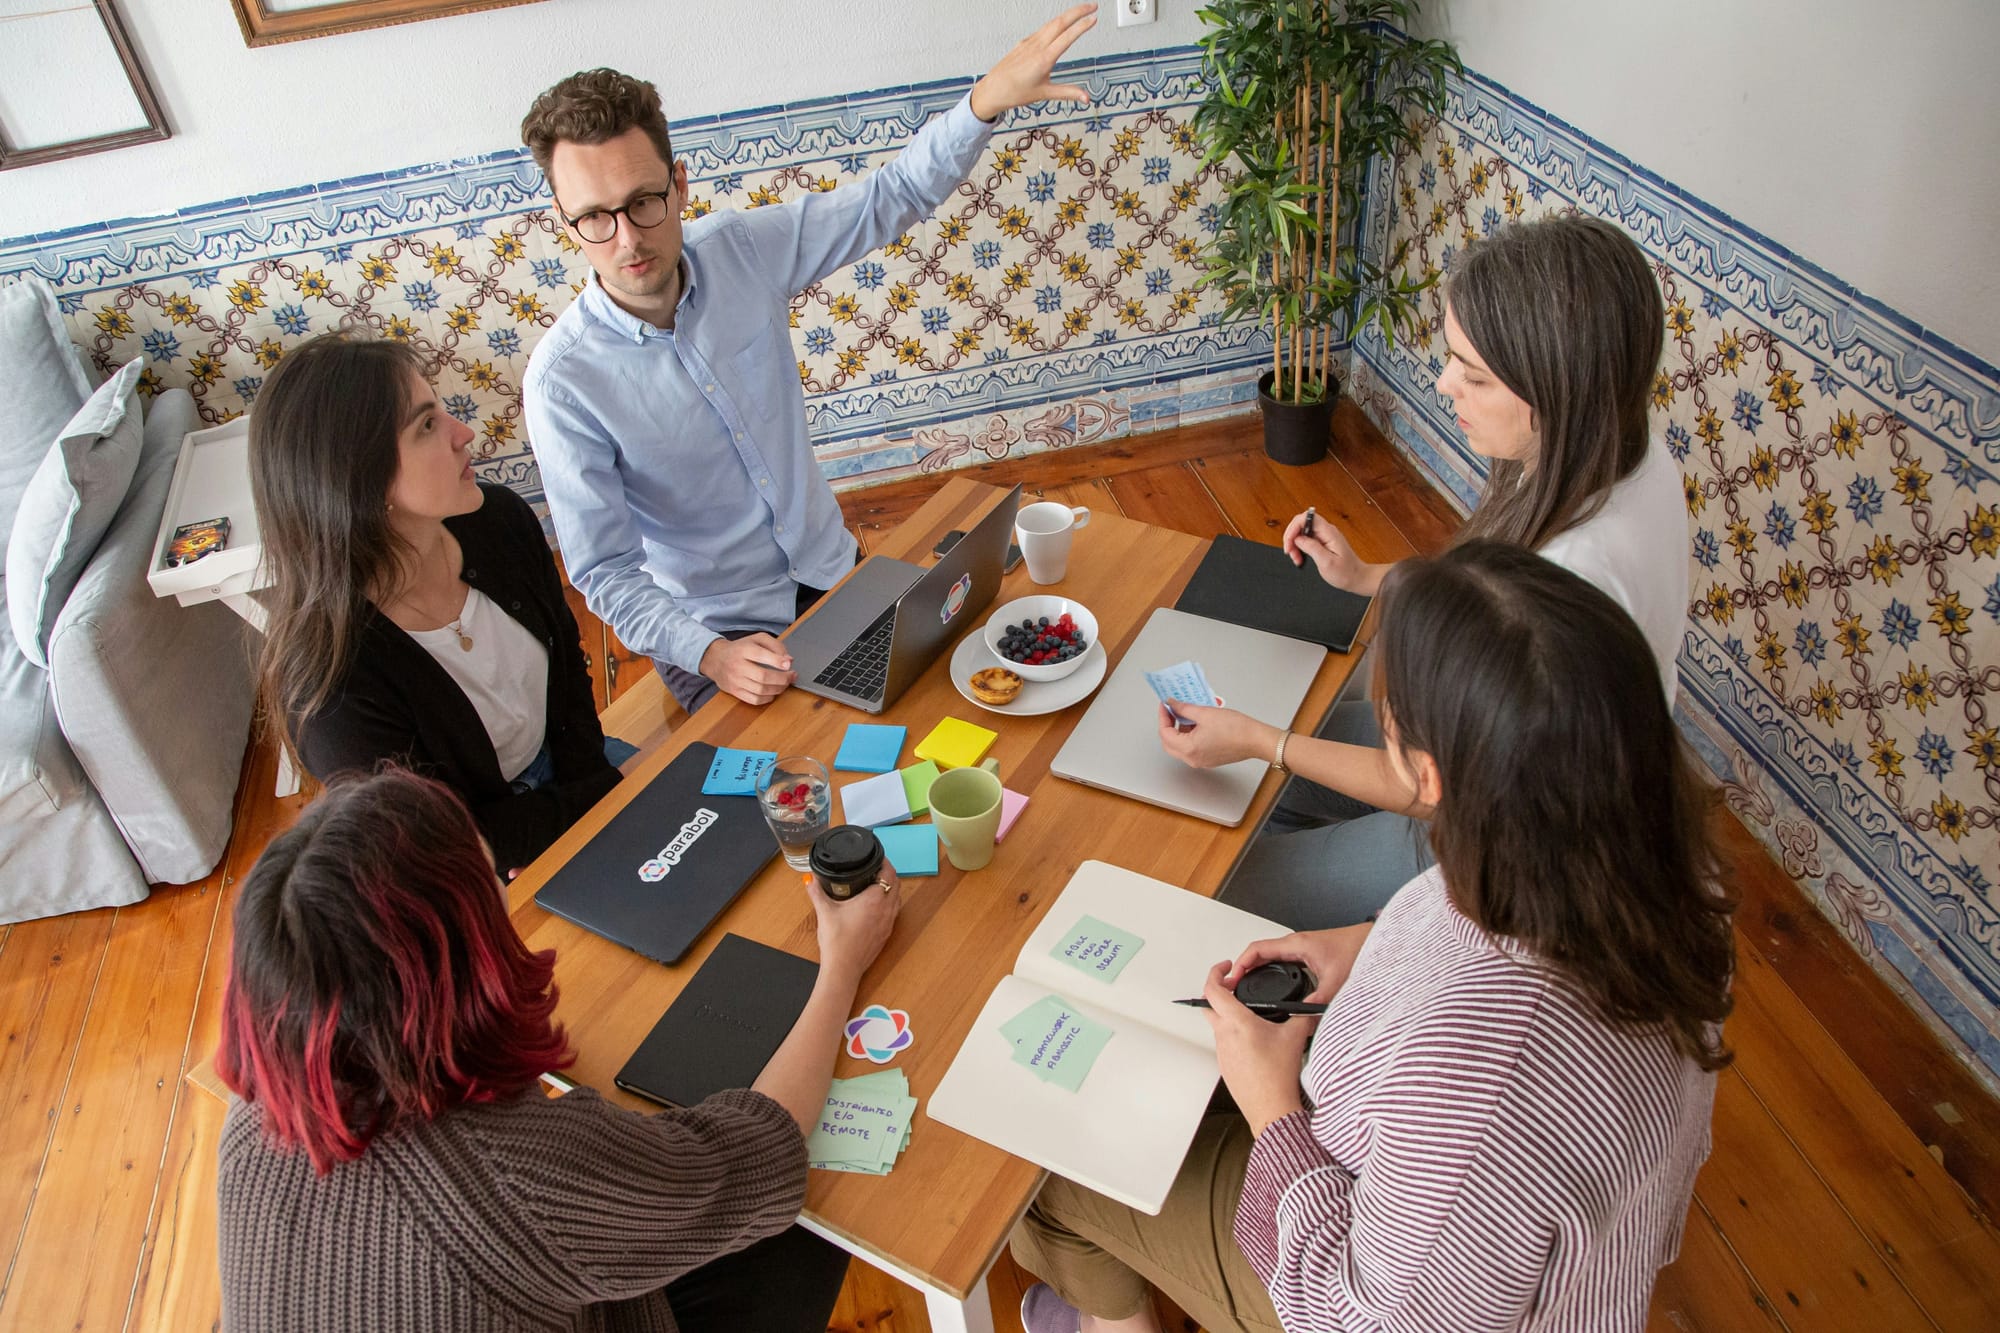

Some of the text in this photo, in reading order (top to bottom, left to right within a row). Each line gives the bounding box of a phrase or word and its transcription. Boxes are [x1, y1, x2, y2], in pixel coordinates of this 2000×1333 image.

[663, 811, 713, 861] parabol
[1030, 1011, 1071, 1066] FRAMEWORK
[1047, 1026, 1080, 1070] AGNOSTIC
[822, 1122, 870, 1140] REMOTE
[833, 1110, 854, 1120] E/O
